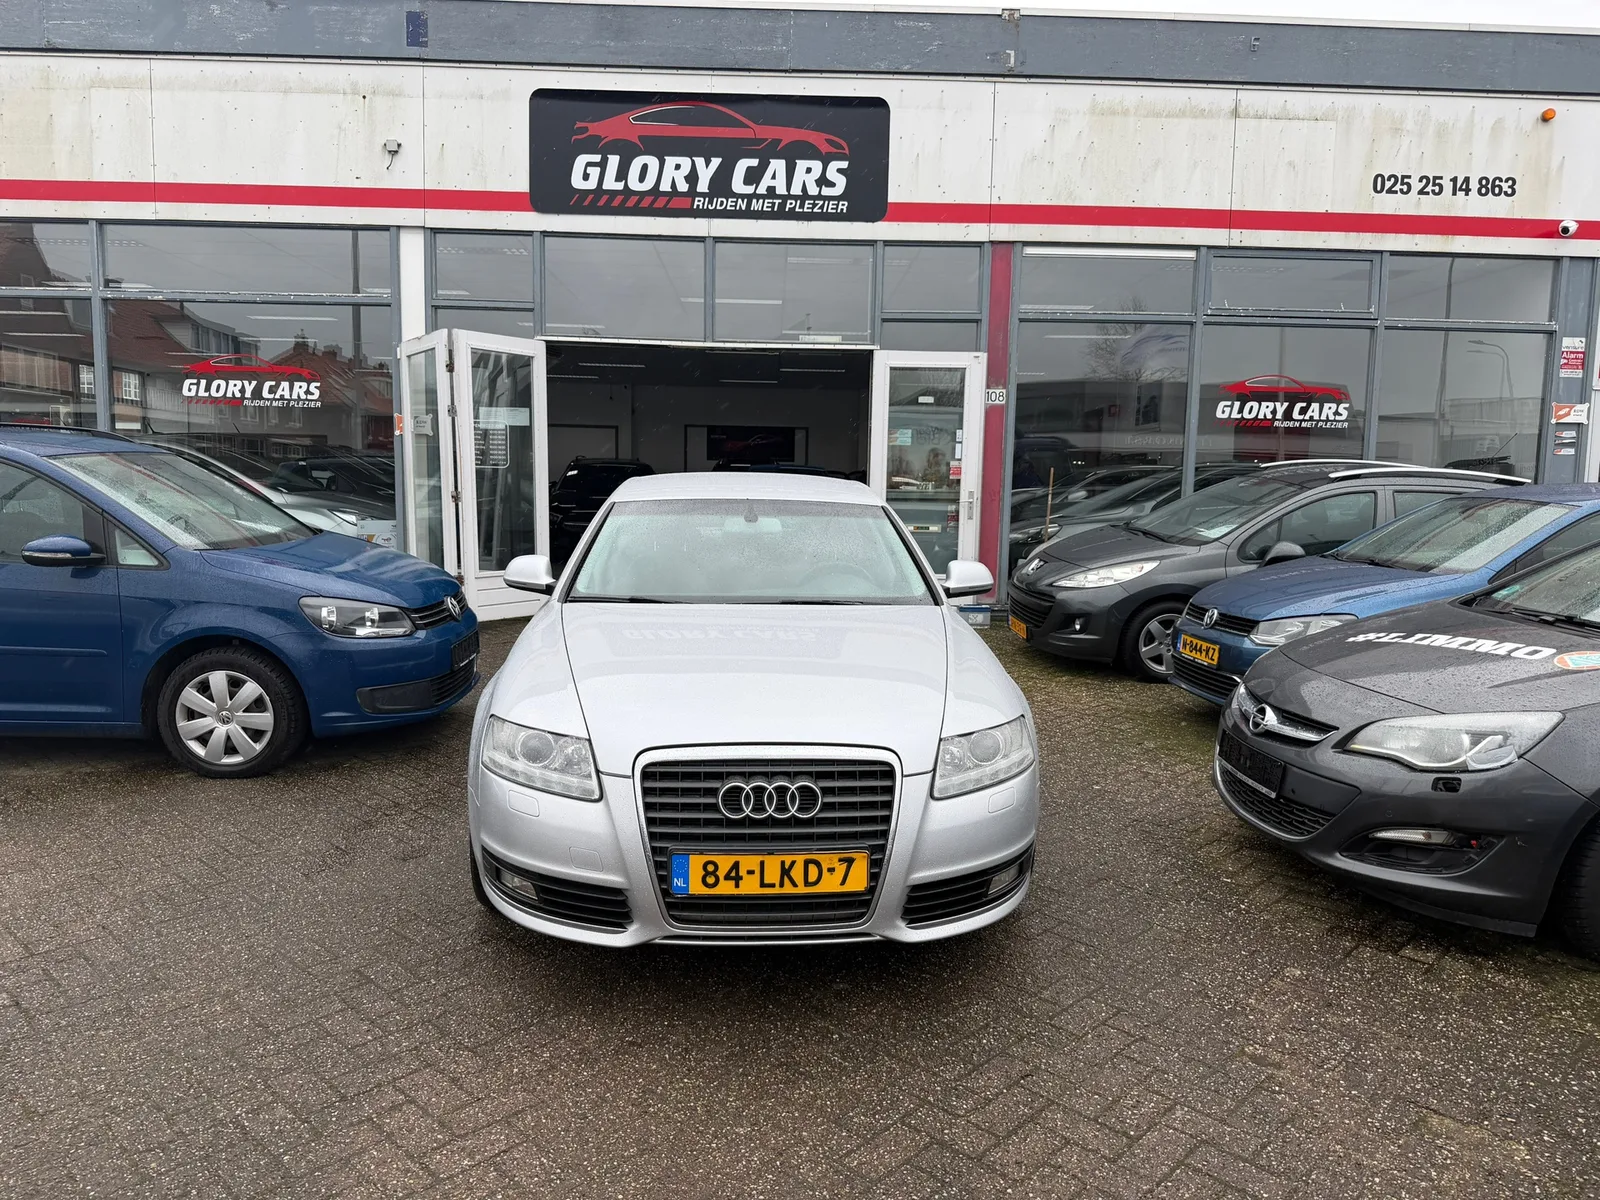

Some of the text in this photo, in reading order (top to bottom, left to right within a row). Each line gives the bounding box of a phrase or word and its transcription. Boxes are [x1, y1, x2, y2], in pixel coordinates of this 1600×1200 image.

[570, 153, 849, 197] GLORY CARS
[1372, 173, 1517, 198] 025 25 14 863
[693, 197, 848, 214] RIJDEN MET PLEZIER
[1561, 351, 1584, 359] Alarm
[182, 378, 321, 400] GLORY CARS
[986, 391, 1005, 402] 108
[243, 399, 270, 407] RIJDEN
[289, 400, 321, 408] PLEZIER
[1216, 400, 1349, 421] GLORY CARS
[1273, 420, 1299, 428] RIJDEN
[1317, 421, 1348, 429] PLEZIER
[1345, 632, 1557, 660] #LIMMO
[673, 857, 856, 889] NL 84-LKD-7
